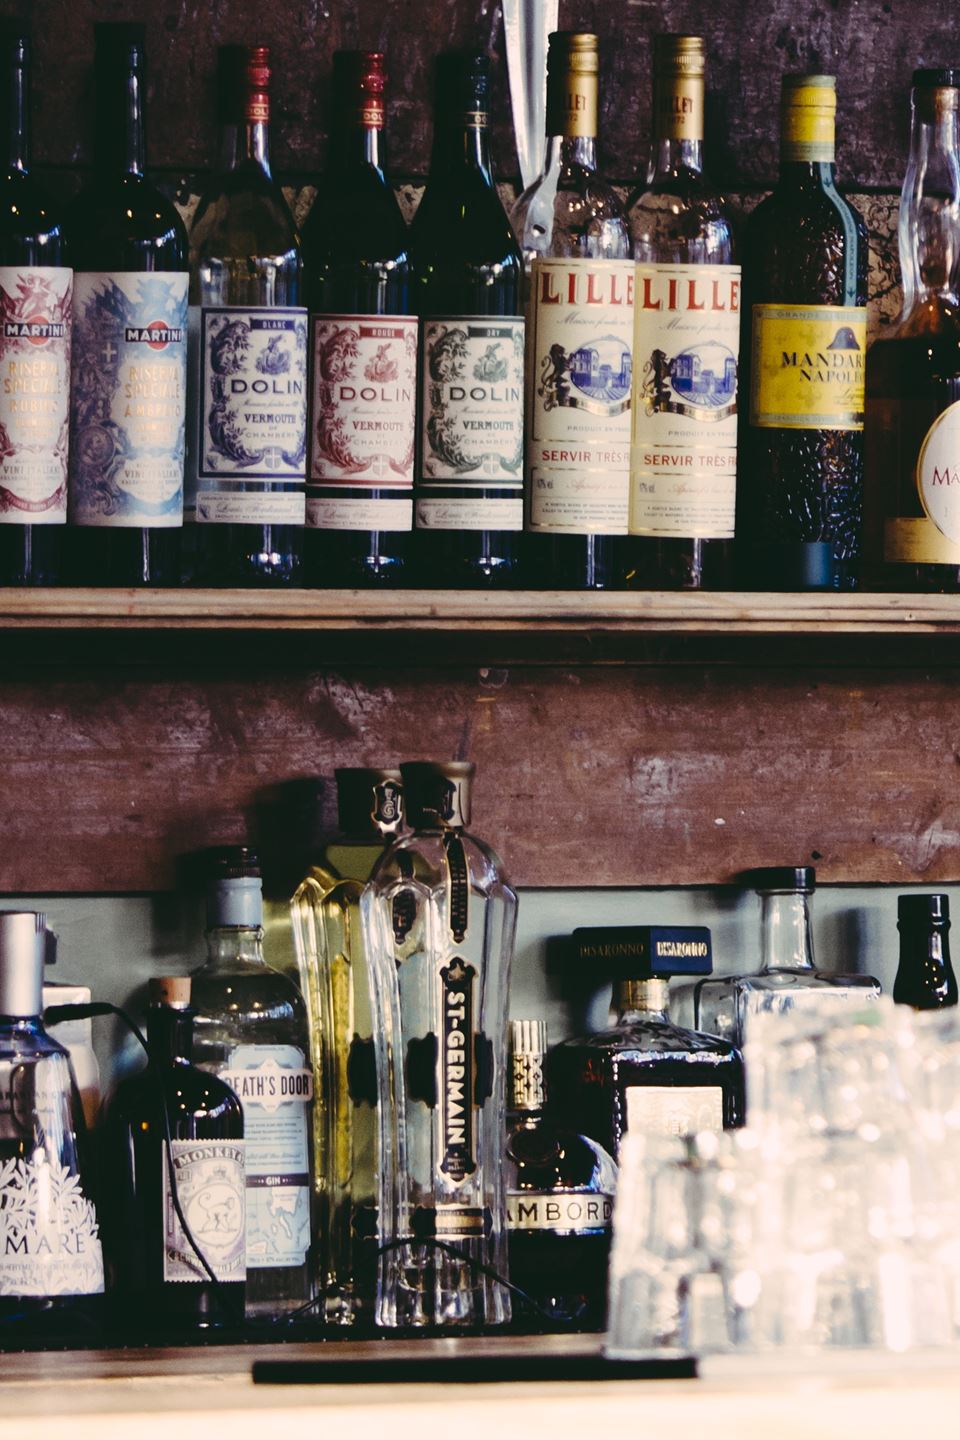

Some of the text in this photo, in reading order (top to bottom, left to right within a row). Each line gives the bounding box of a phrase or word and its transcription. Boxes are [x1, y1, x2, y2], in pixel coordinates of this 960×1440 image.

[541, 271, 634, 305] LILLE
[642, 277, 739, 312] LILLE
[7, 324, 65, 338] MARTINI
[127, 329, 182, 343] MARTINI
[231, 379, 303, 395] DOLIN
[339, 386, 411, 402] DOLIN
[450, 386, 520, 402] DOLIN
[541, 450, 592, 463] SERVIR
[643, 453, 694, 466] SERVIR
[579, 942, 646, 958] DISARONNO
[656, 940, 709, 958] DISARONNO
[447, 990, 467, 1146] ST-GERMAIN
[280, 1074, 309, 1096] DOOR
[179, 1146, 239, 1166] MONKEY
[265, 1176, 281, 1186] GIN
[4, 1232, 87, 1256] MARE
